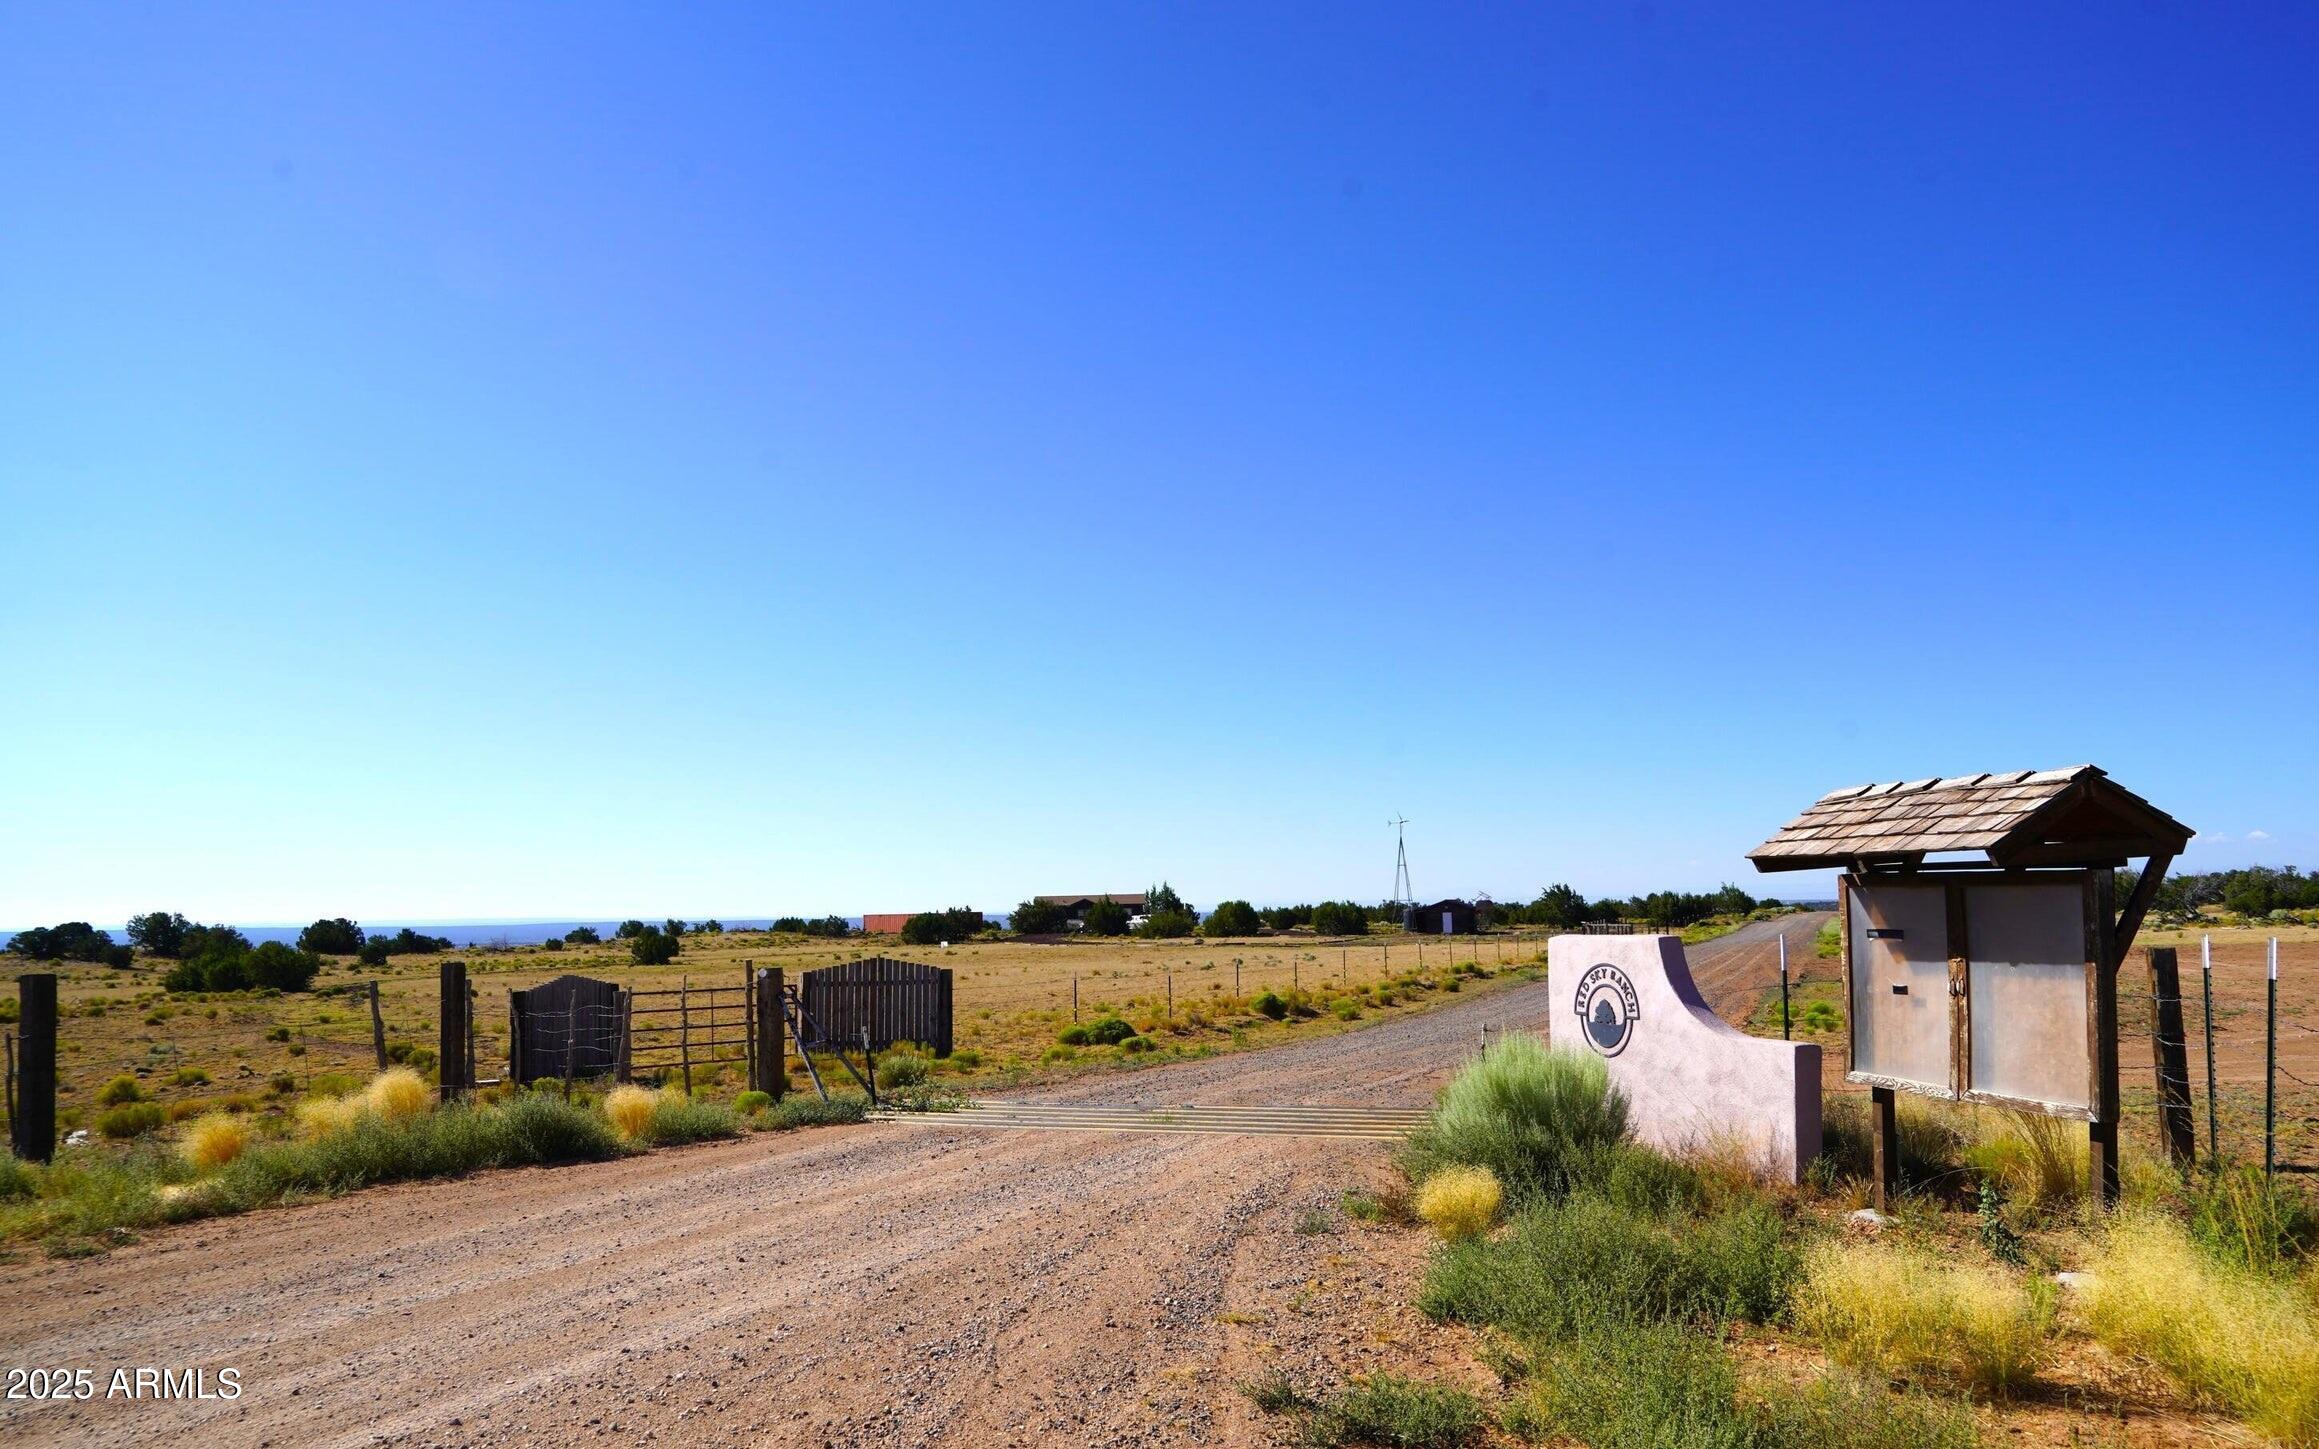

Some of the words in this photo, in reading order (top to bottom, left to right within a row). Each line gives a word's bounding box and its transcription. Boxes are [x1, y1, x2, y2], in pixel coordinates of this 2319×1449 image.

[1577, 982, 1590, 1008] RED
[1590, 968, 1607, 984] SKY
[1610, 970, 1635, 1013] RANCH
